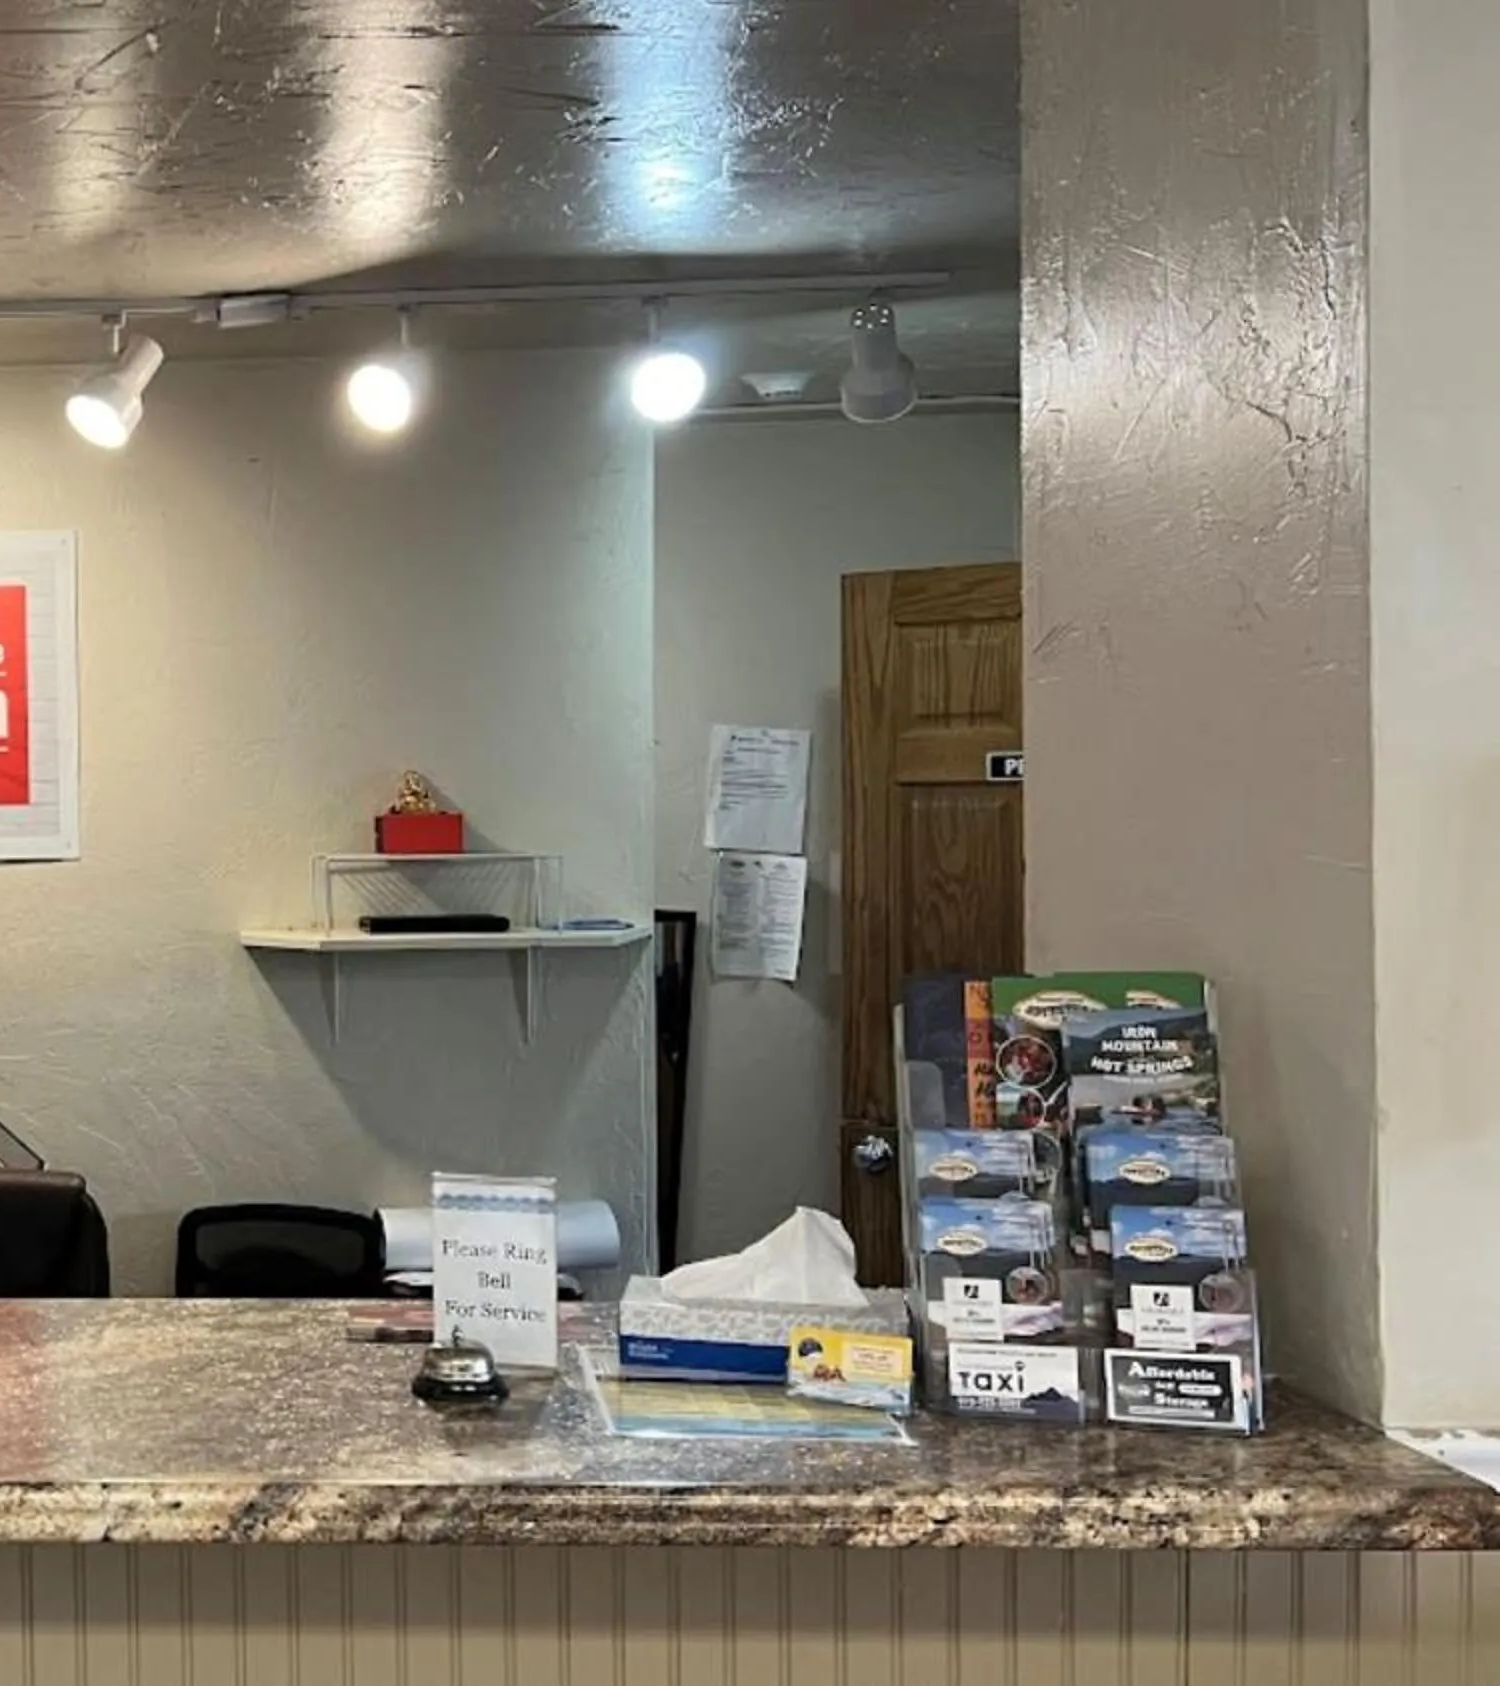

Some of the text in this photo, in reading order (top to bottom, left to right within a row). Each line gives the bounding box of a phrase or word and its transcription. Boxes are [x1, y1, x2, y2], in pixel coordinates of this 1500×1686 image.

[1101, 1040, 1178, 1052] MOUNTAIN
[442, 1239, 547, 1265] Please Ring
[477, 1271, 511, 1289] Bell
[445, 1301, 547, 1322] For Service
